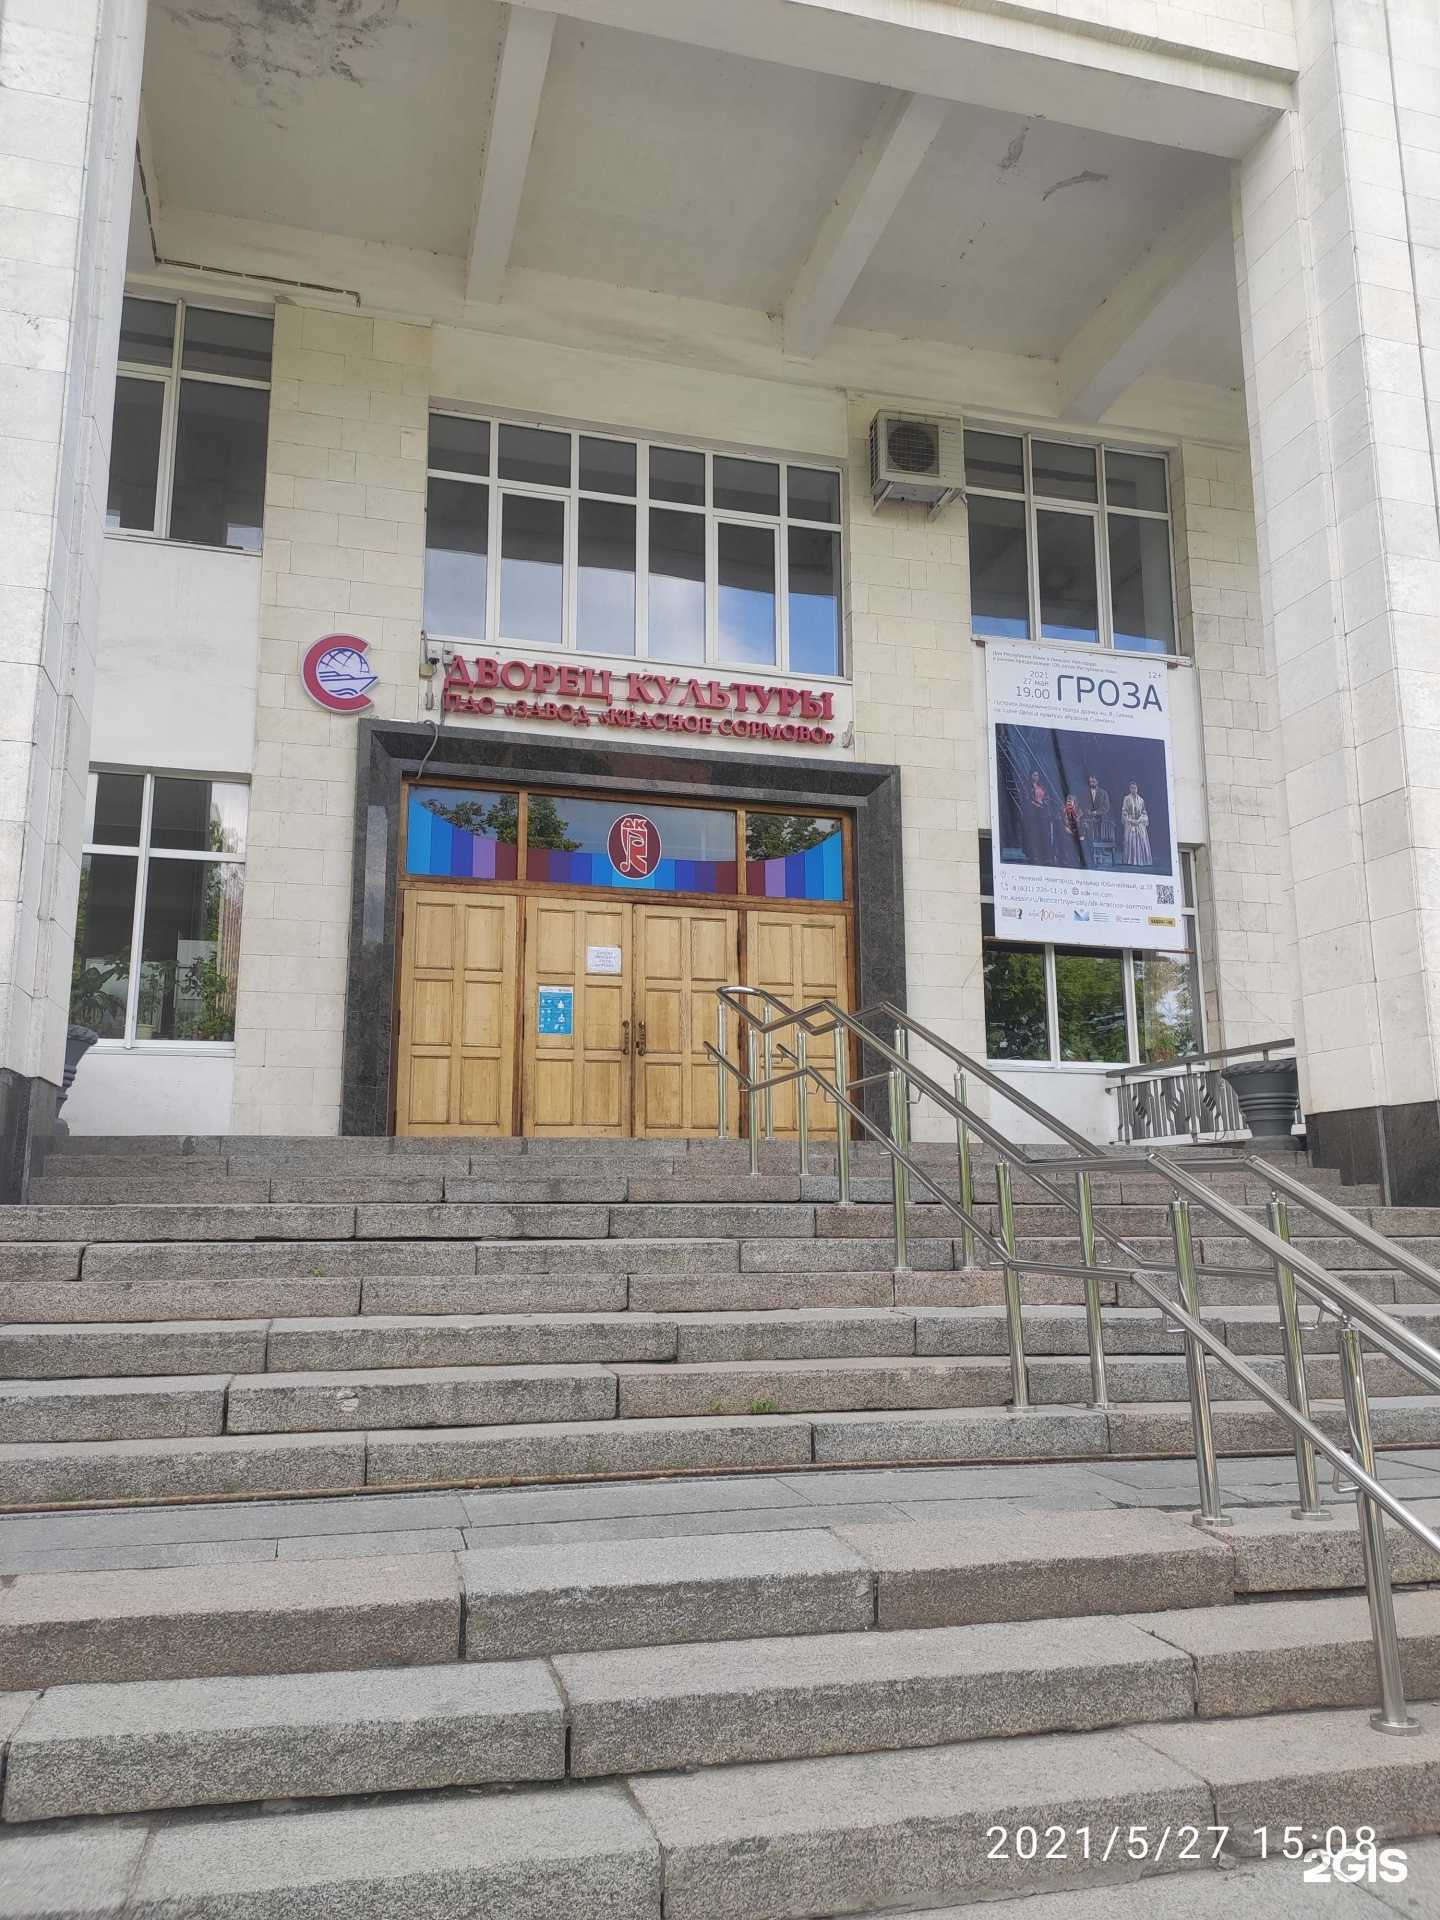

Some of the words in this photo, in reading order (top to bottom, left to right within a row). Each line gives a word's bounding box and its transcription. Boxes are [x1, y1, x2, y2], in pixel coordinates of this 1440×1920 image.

[446, 654, 613, 706] ДВОРЕЦ
[626, 671, 834, 720] КУЛЬТУРЫ
[1016, 686, 1050, 700] 19.00
[1030, 670, 1049, 679] 2021
[1057, 674, 1163, 712] ГРОЗА
[444, 693, 497, 716] ПАО
[504, 699, 590, 728] «ЗАВОД
[598, 707, 713, 735] «КРАСНОЕ
[718, 718, 835, 746] СОРМОВО»
